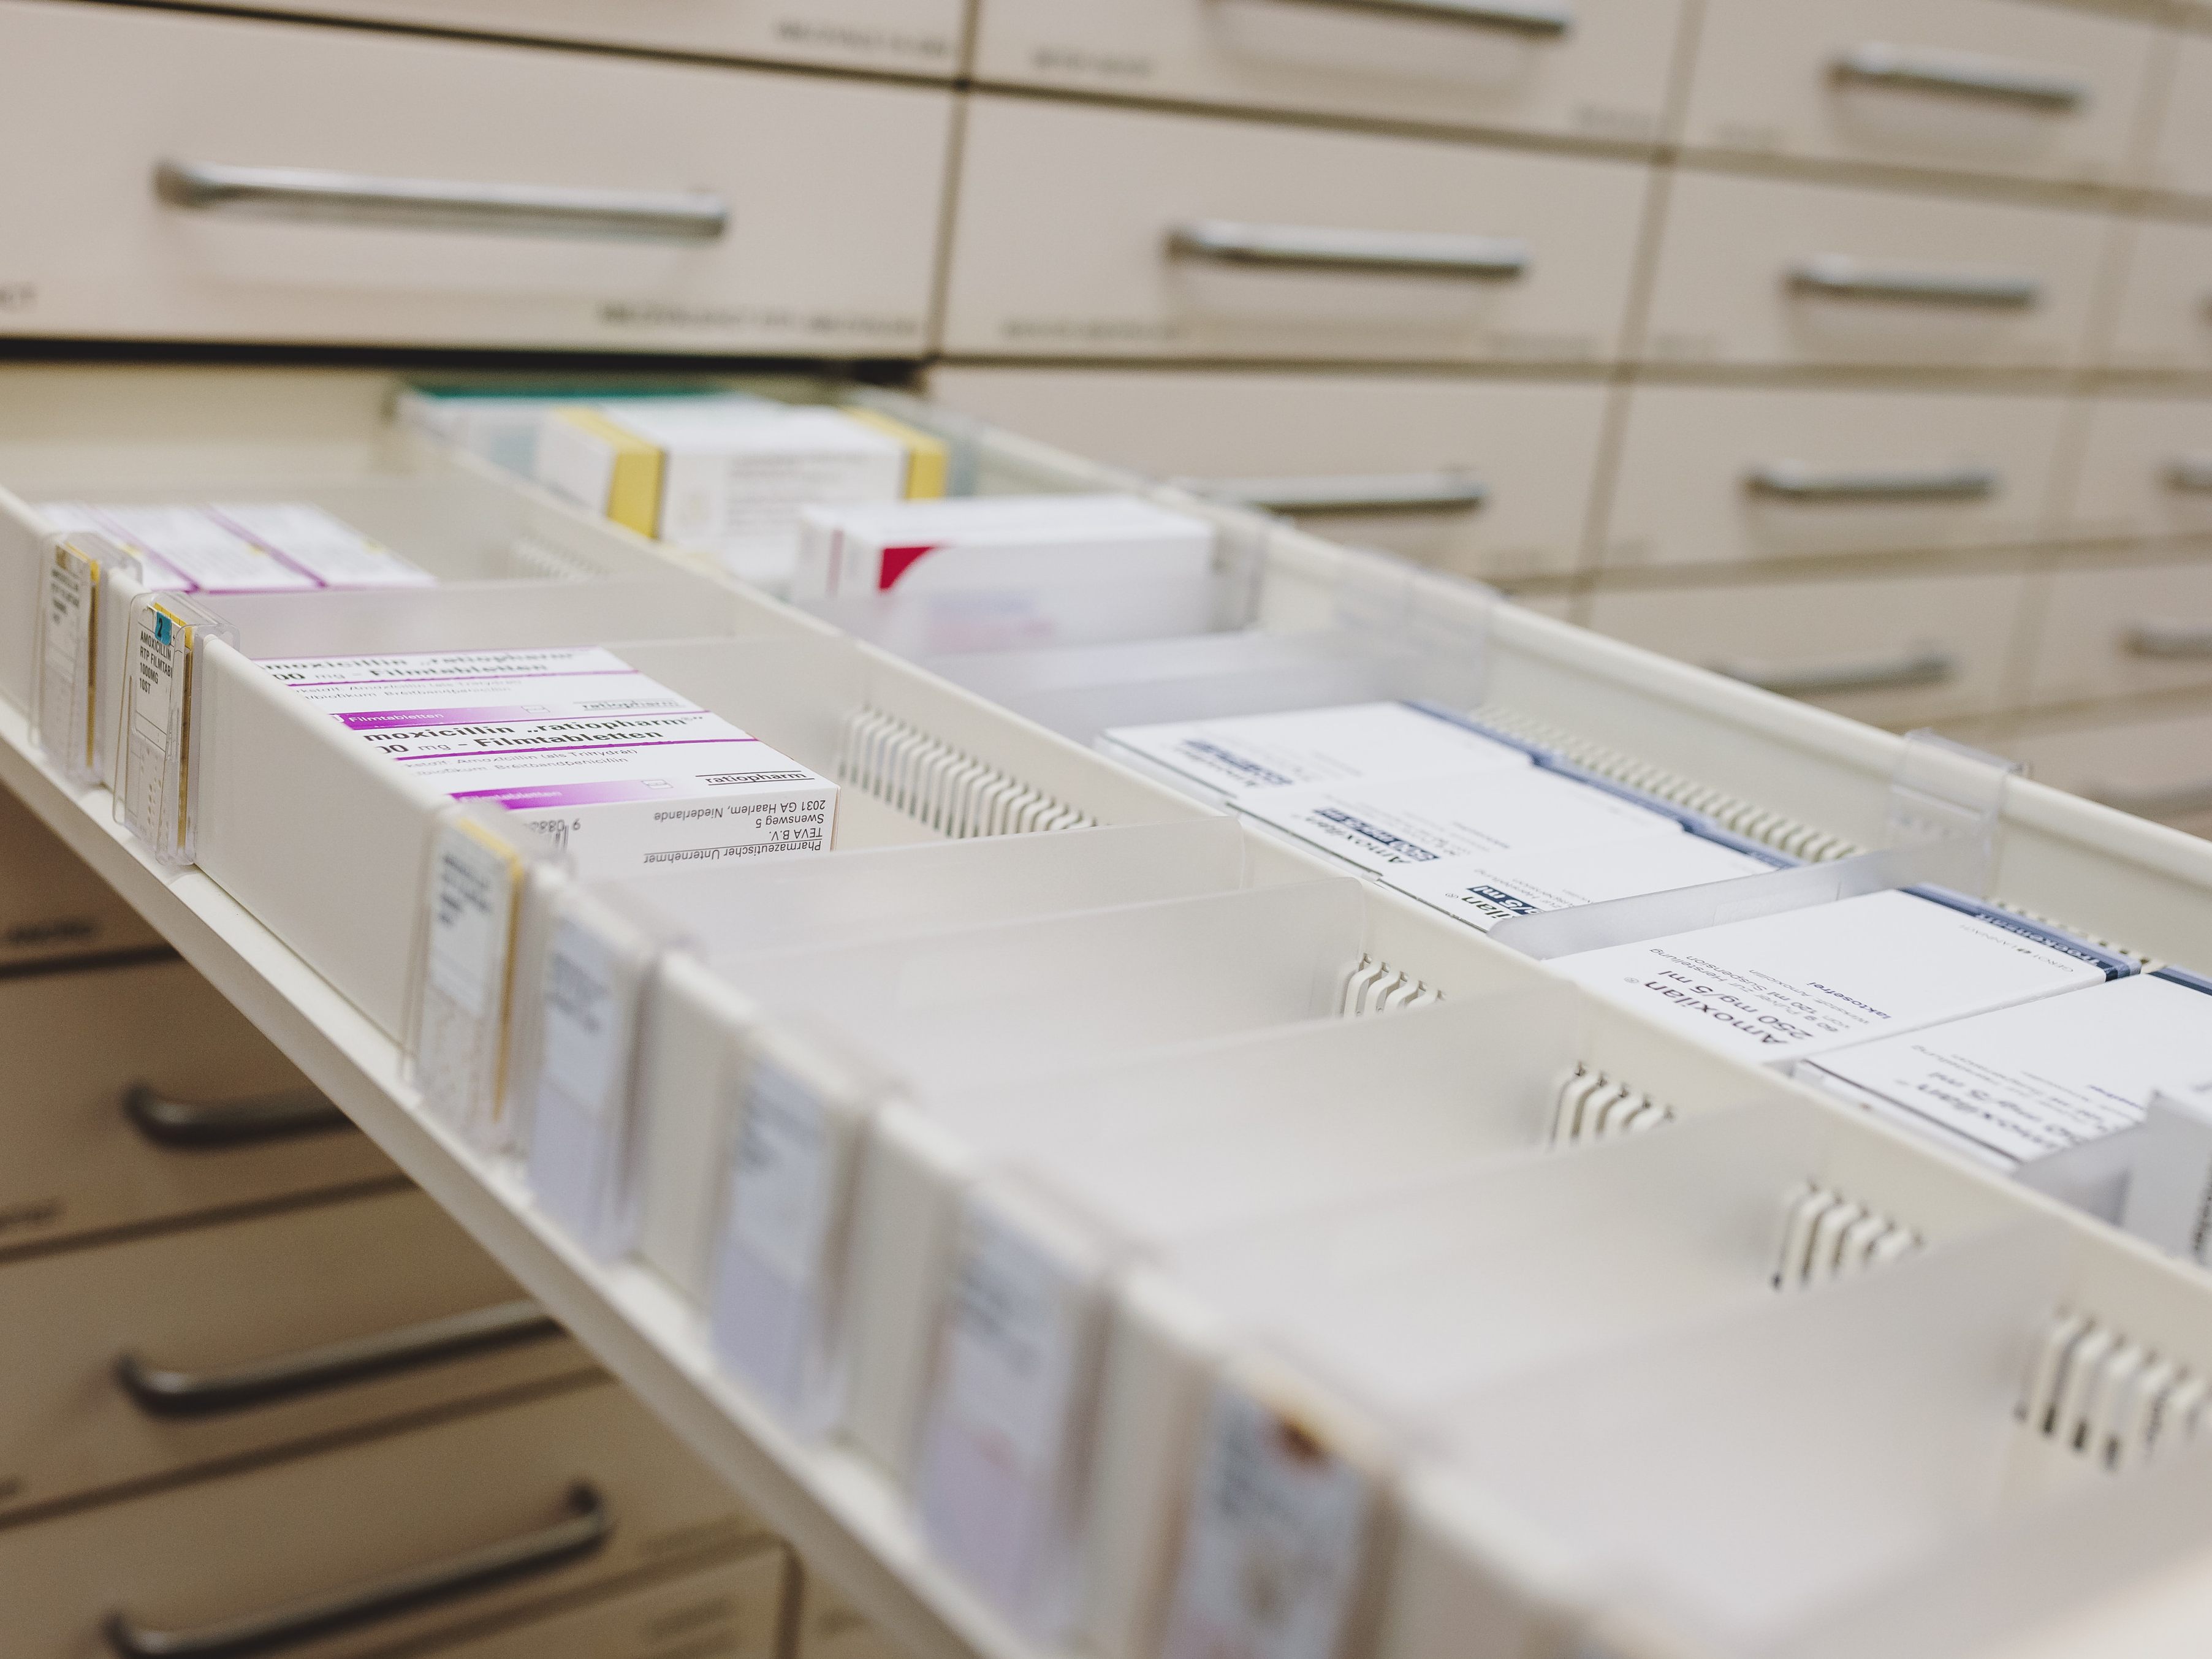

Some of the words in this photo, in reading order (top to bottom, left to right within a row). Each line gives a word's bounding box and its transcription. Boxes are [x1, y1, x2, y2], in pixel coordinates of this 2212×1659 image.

[157, 617, 164, 638] 2
[140, 630, 172, 662] AMOXICILLIN
[140, 645, 150, 661] RTP
[265, 658, 408, 670] moxicillin
[140, 662, 159, 685] 1000MG
[139, 677, 151, 695] 10ST
[348, 713, 444, 723] Filmtabletten
[363, 726, 515, 742] moxicillin
[473, 731, 664, 748] Filmtabletten
[494, 757, 629, 770] Breitbandpenicillin
[704, 770, 807, 785] ratiopharm
[727, 803, 777, 816] Haarlem,
[780, 801, 797, 813] GA
[800, 799, 826, 810] 2031
[653, 807, 724, 822] Niederlande
[766, 813, 825, 826] Swensweg
[755, 818, 762, 829] 5
[768, 829, 790, 841] B.V.
[794, 827, 823, 838] TEVA
[723, 840, 822, 857] Pharmazeutischer
[643, 849, 720, 864] Unternehmer
[1472, 886, 1506, 900] ml
[1649, 948, 1728, 982] Herstellung
[1657, 970, 1693, 984] ml
[1686, 956, 1768, 992] Suspension
[1728, 982, 1754, 993] zur
[1749, 969, 1812, 997] Amoxicillin
[1689, 985, 1758, 1013] mg/5
[1767, 991, 1791, 1001] ml
[1806, 981, 1892, 1020] laktosefrei
[1753, 994, 1803, 1016] Pulver
[1757, 1015, 1814, 1040] 250
